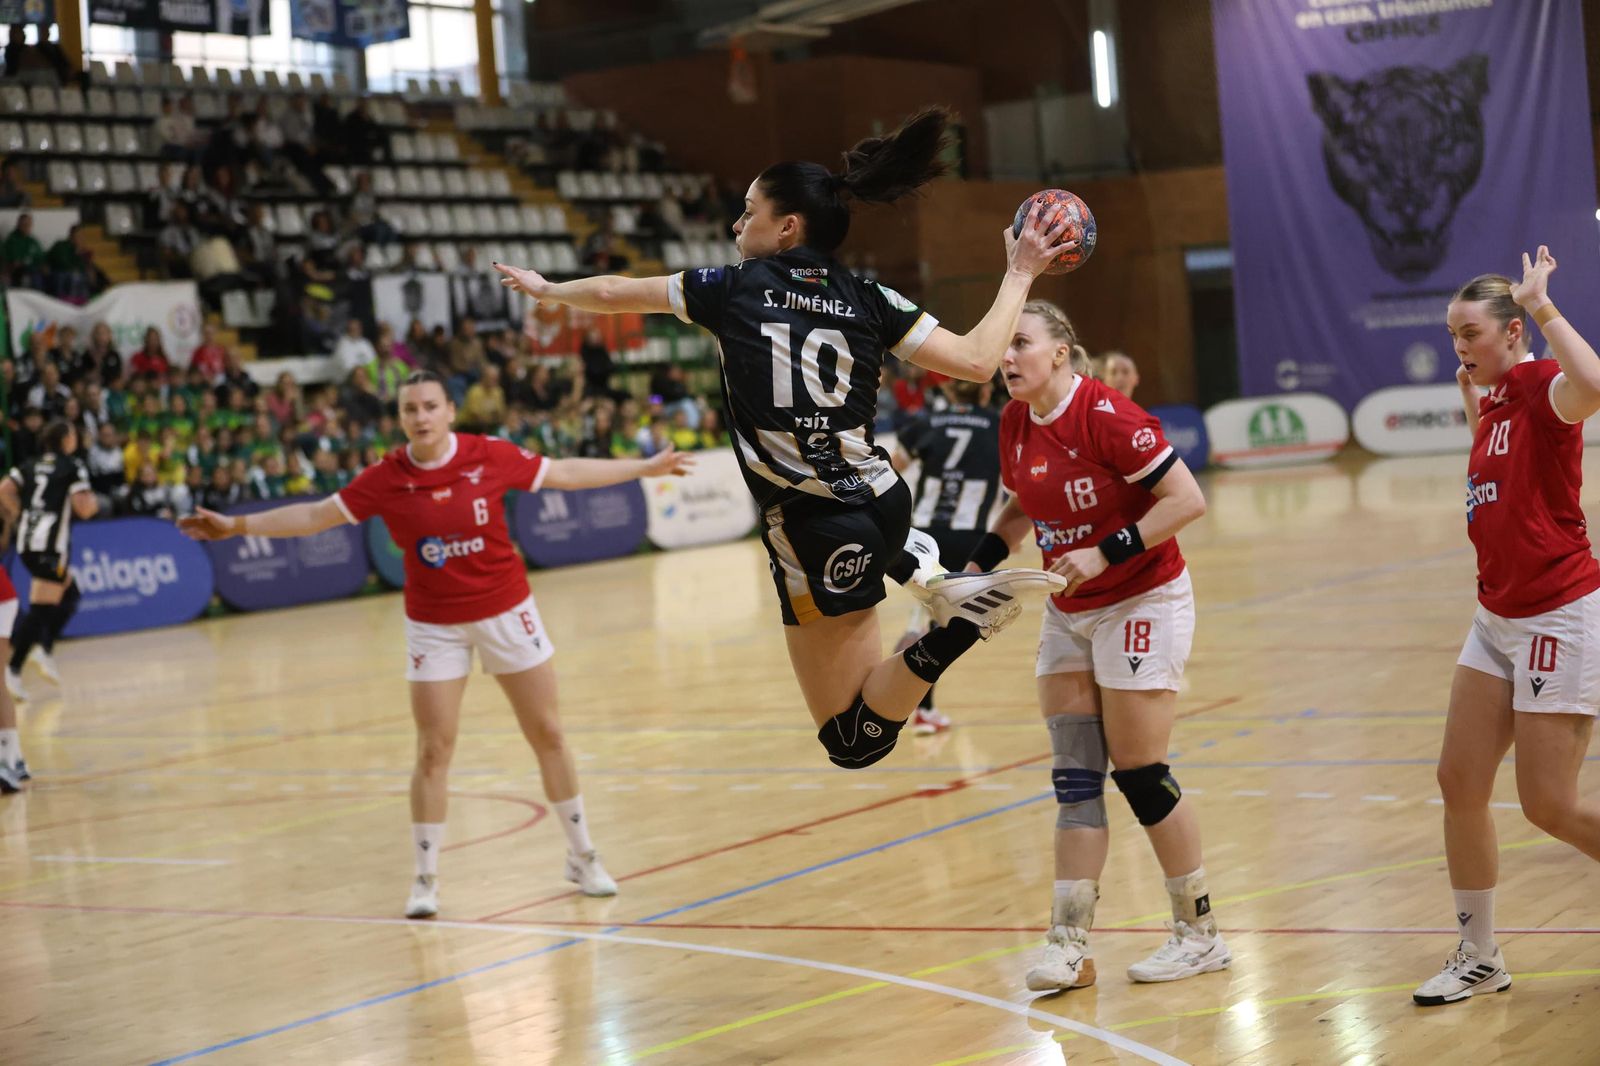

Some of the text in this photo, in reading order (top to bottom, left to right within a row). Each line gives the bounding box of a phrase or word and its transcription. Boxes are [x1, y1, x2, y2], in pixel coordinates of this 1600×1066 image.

[782, 291, 856, 317] JIMÉNEZ
[761, 322, 854, 408] 10
[944, 427, 973, 471] 7
[1487, 419, 1511, 457] 10
[1064, 476, 1098, 512] 18
[473, 497, 489, 526] 6
[421, 536, 485, 563] extra
[833, 553, 872, 580] CSIF
[519, 611, 535, 635] 6
[1124, 620, 1151, 653] 18
[1529, 635, 1557, 672] 10
